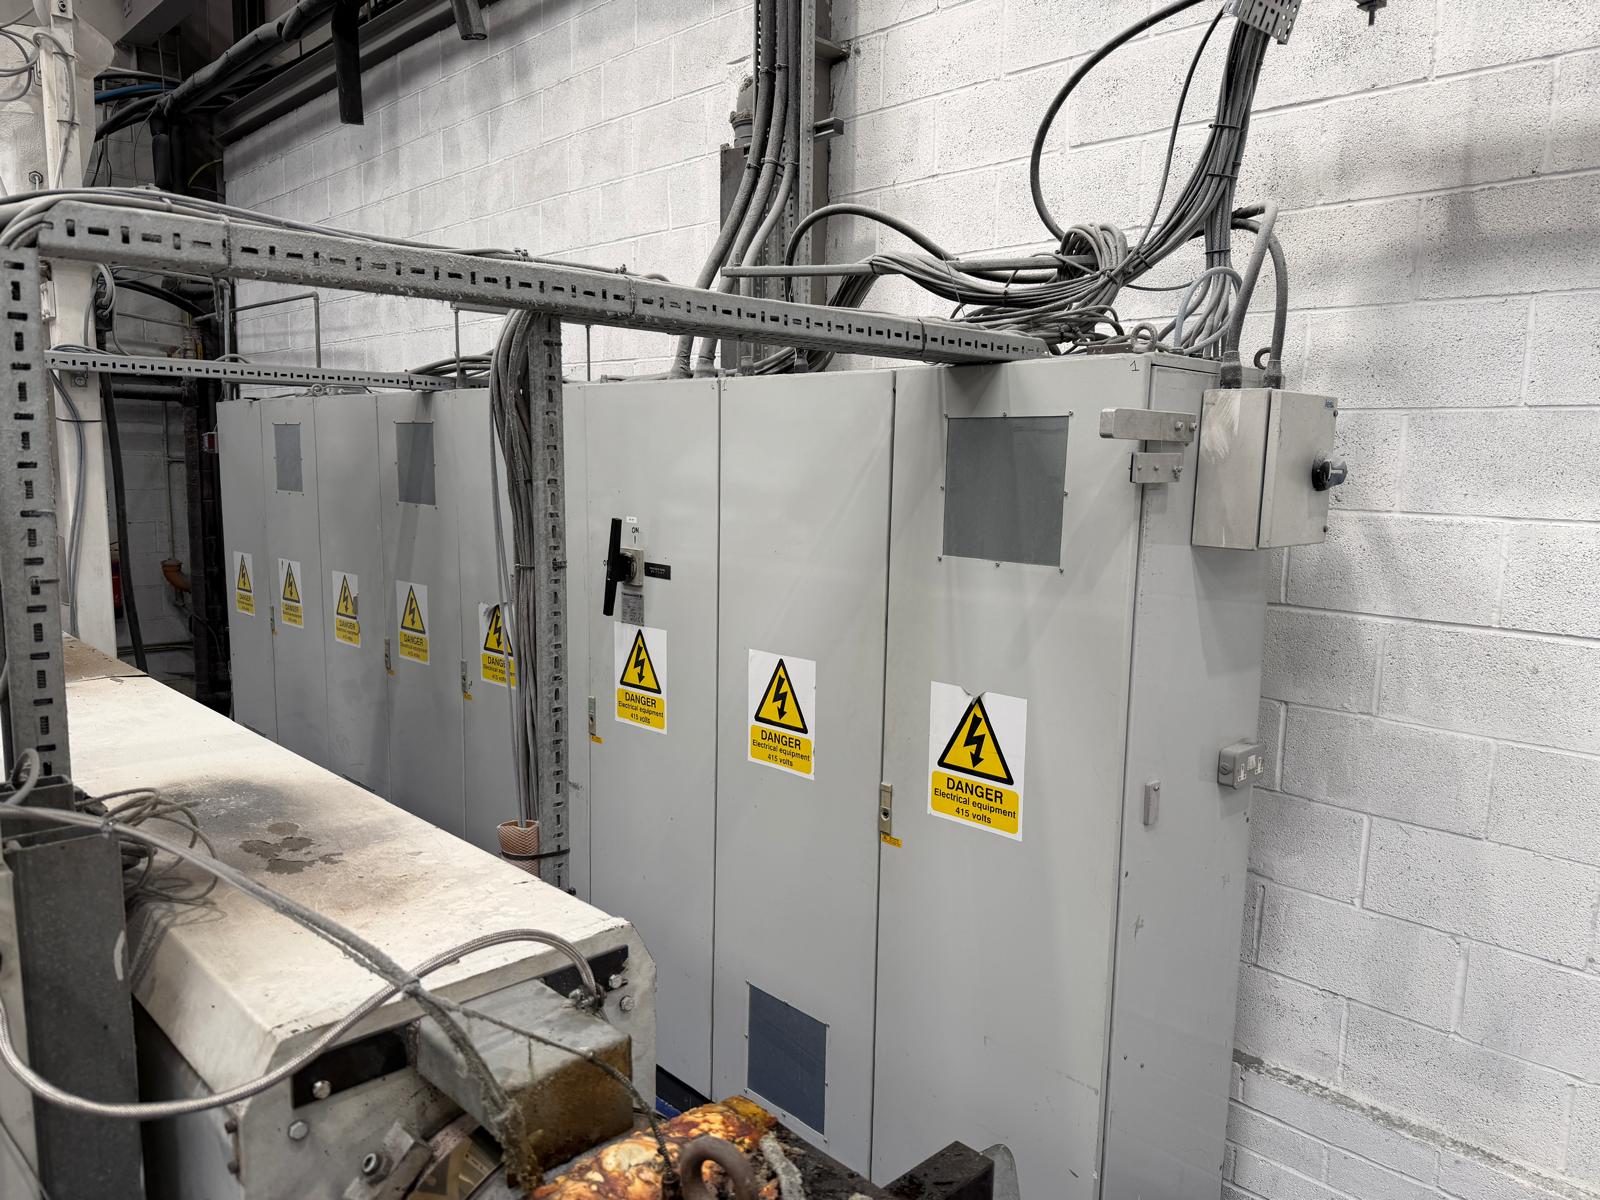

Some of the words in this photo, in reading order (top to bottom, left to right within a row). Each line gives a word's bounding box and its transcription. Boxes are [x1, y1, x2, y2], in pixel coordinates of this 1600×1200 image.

[1129, 360, 1140, 371] 1
[631, 526, 640, 534] ON
[403, 633, 424, 647] DANGER
[618, 701, 638, 711] Electrical
[625, 692, 656, 709] DANGER
[761, 729, 801, 750] DANGER
[752, 739, 778, 752] Electrical
[779, 748, 810, 761] equipment
[768, 754, 777, 762] 415
[779, 758, 793, 767] volts
[946, 777, 1003, 805] DANGER
[934, 788, 970, 805] Electrical
[972, 800, 1016, 819] equipment
[955, 807, 969, 817] 415
[972, 813, 991, 824] volts
